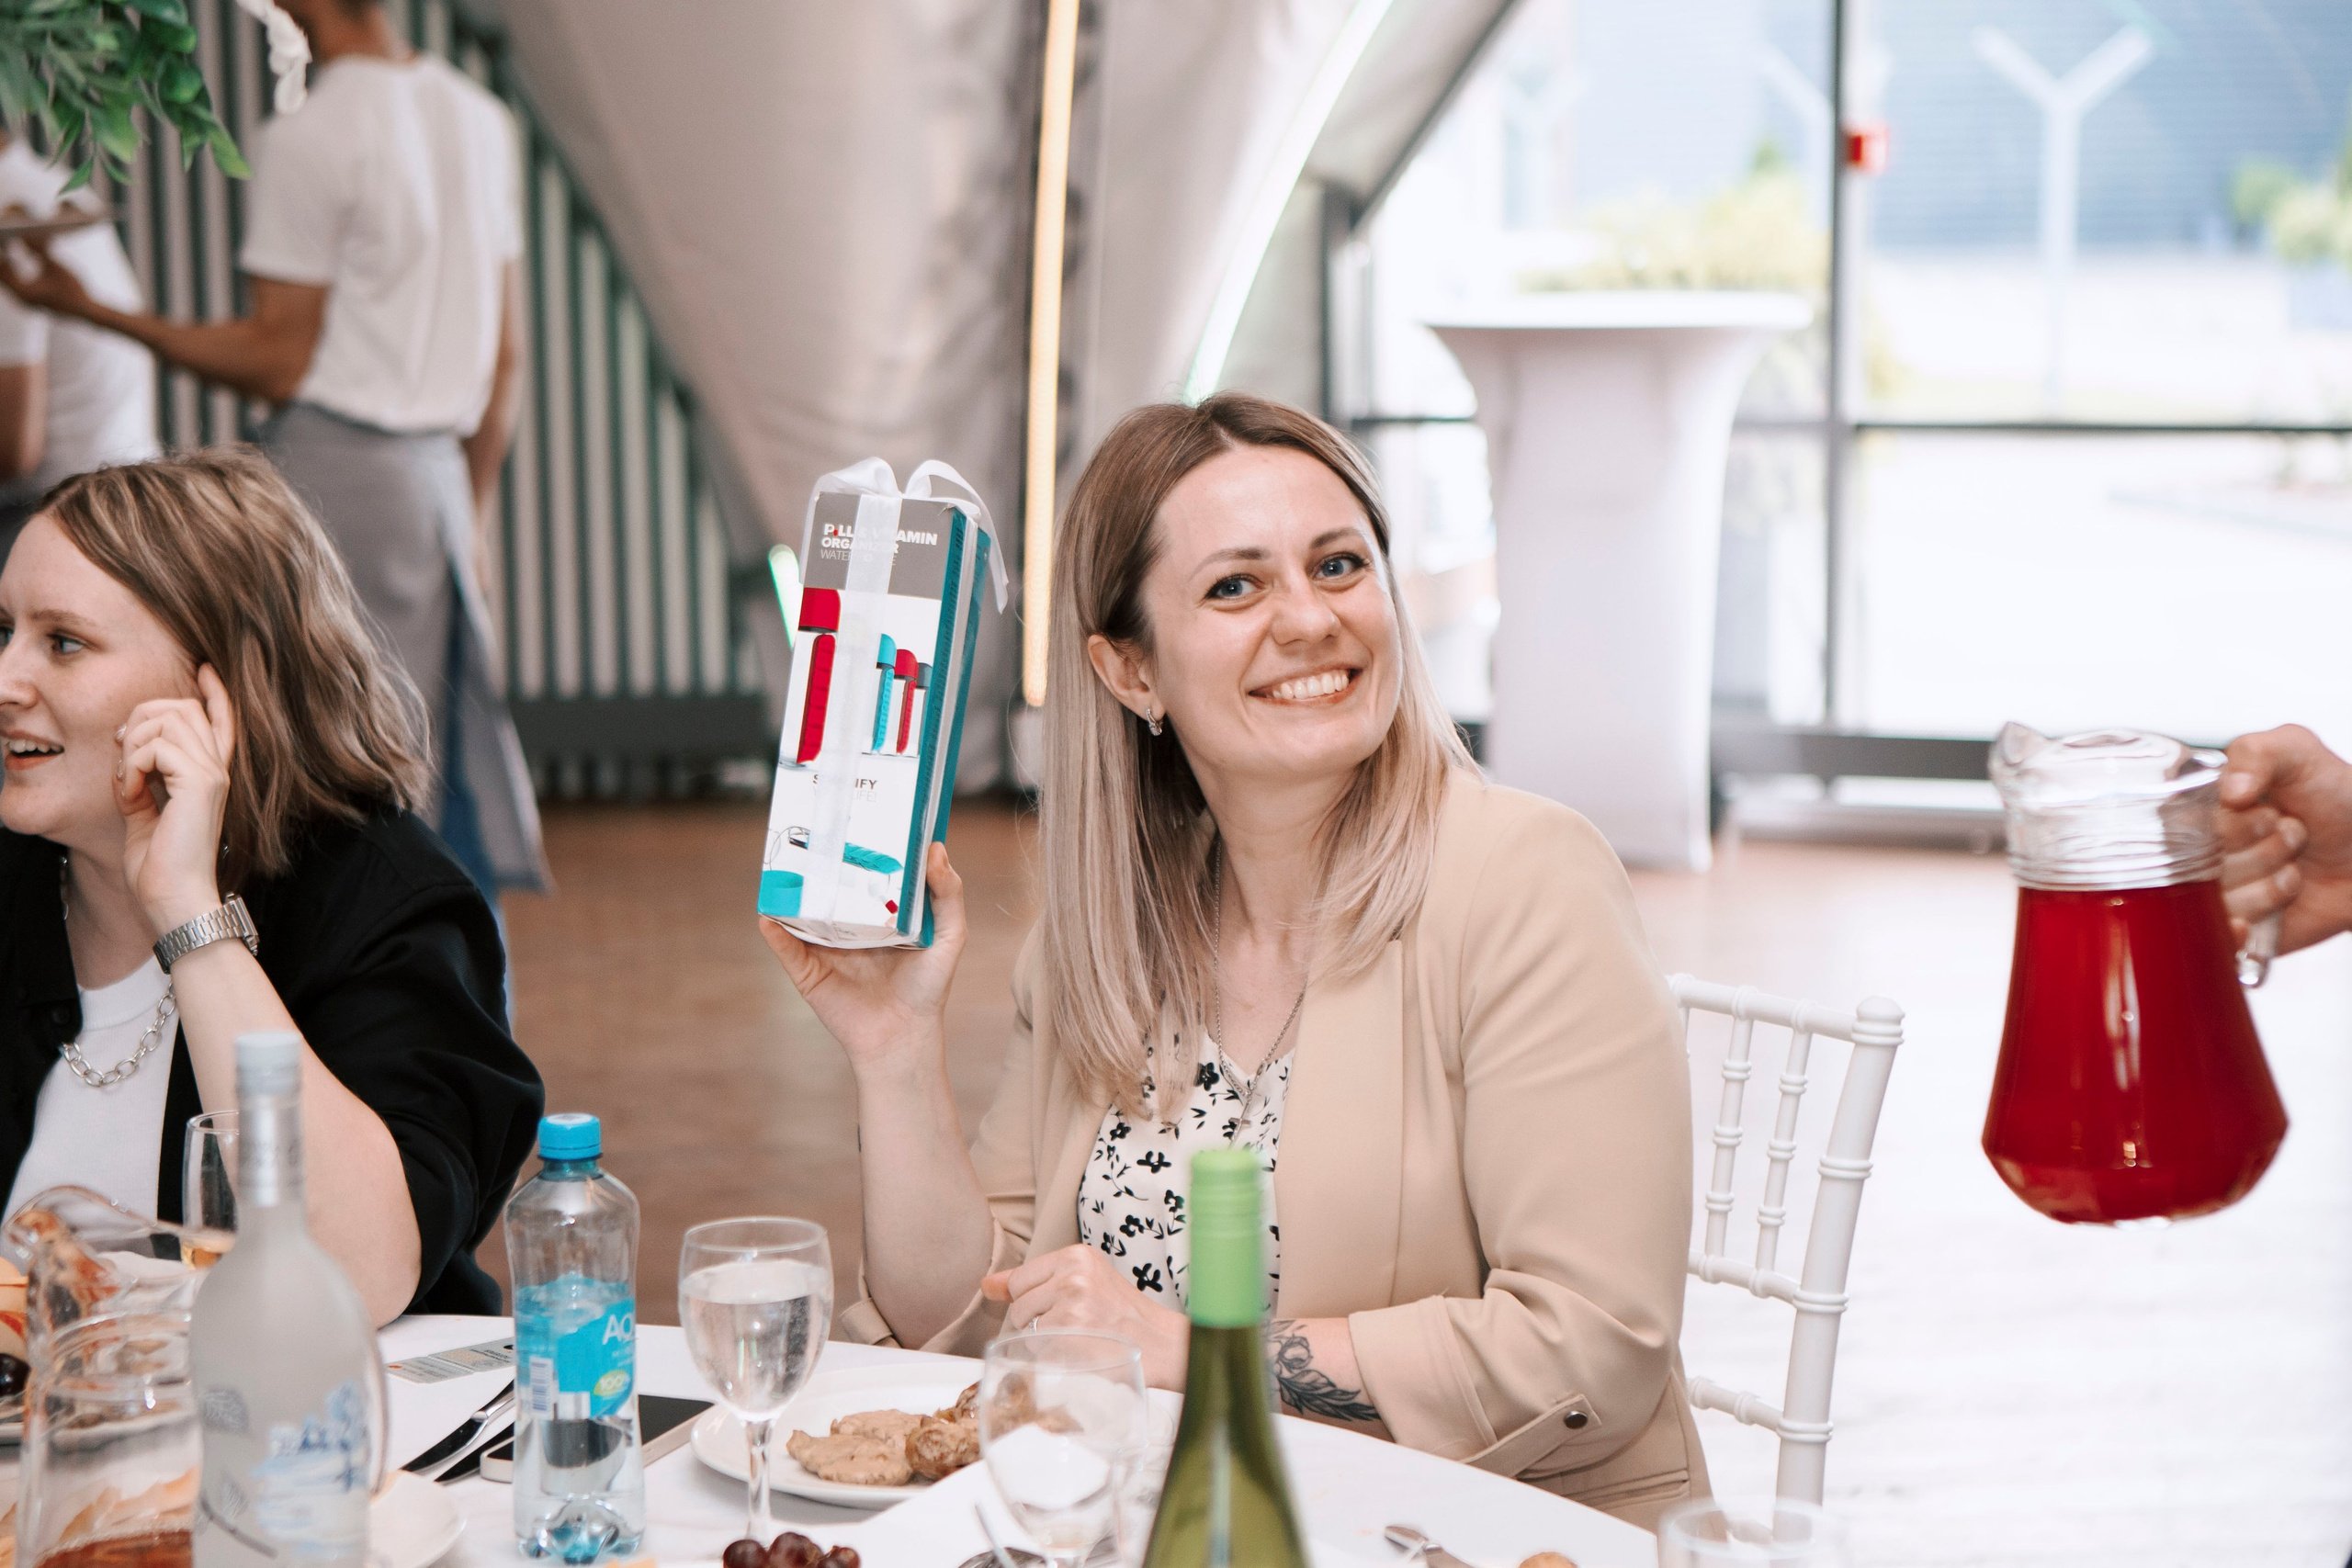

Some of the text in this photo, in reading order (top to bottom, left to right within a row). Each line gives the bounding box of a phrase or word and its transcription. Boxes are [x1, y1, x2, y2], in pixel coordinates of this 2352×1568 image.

[821, 536, 899, 554] ORGANIZR
[871, 526, 938, 546] VAMIN
[820, 549, 851, 561] WATE
